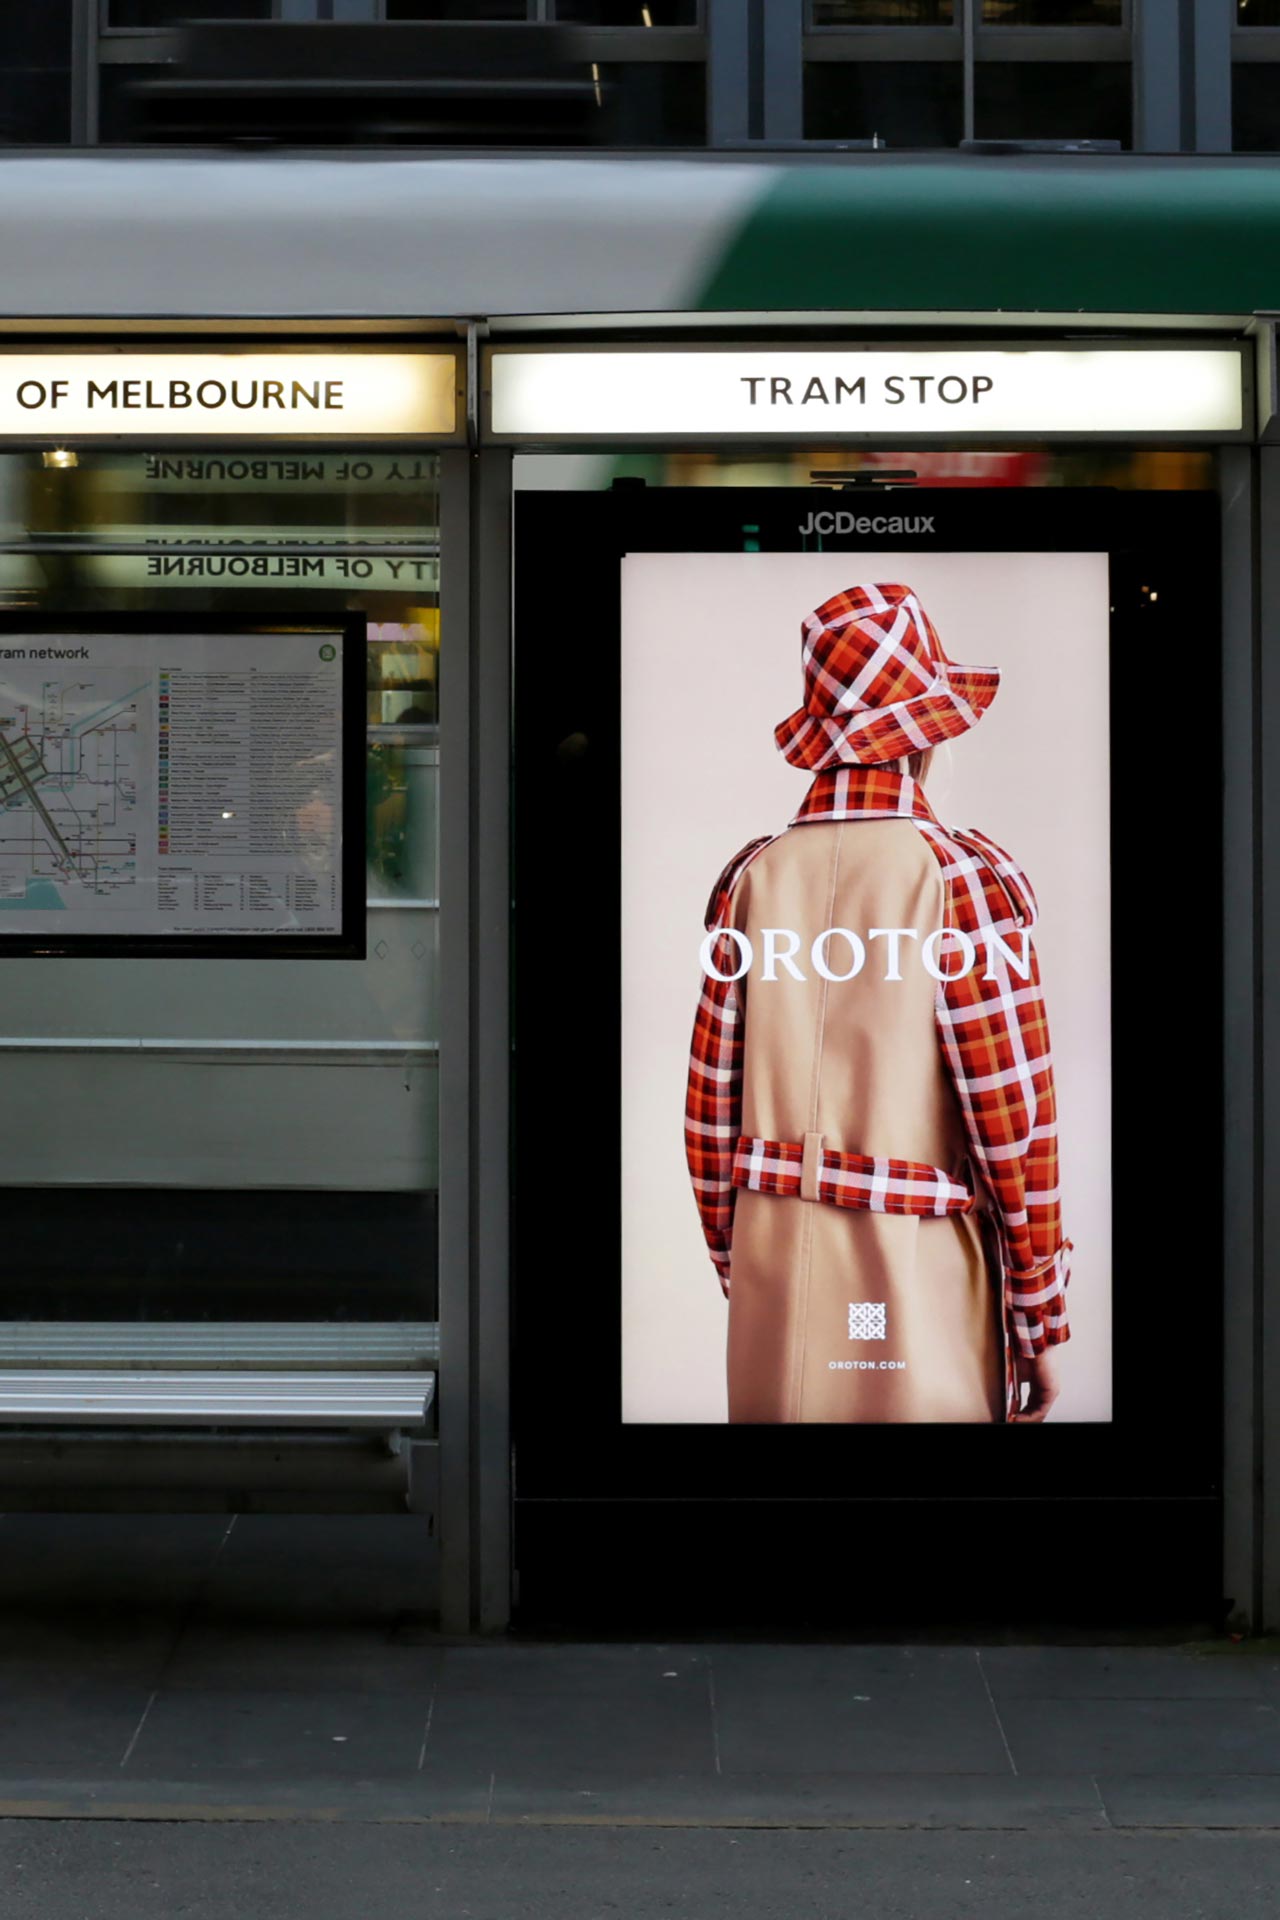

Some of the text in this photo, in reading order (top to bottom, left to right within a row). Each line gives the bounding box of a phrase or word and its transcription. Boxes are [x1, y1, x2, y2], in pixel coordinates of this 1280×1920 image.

[16, 380, 343, 409] OF MELBOURNE
[740, 375, 994, 405] TRAM STOP
[146, 459, 440, 481] ITY OF MELBOURNE
[798, 511, 936, 535] JCDecaux
[29, 646, 89, 659] network
[698, 927, 1034, 983] OROTON
[827, 1361, 907, 1370] OROTON.COM
